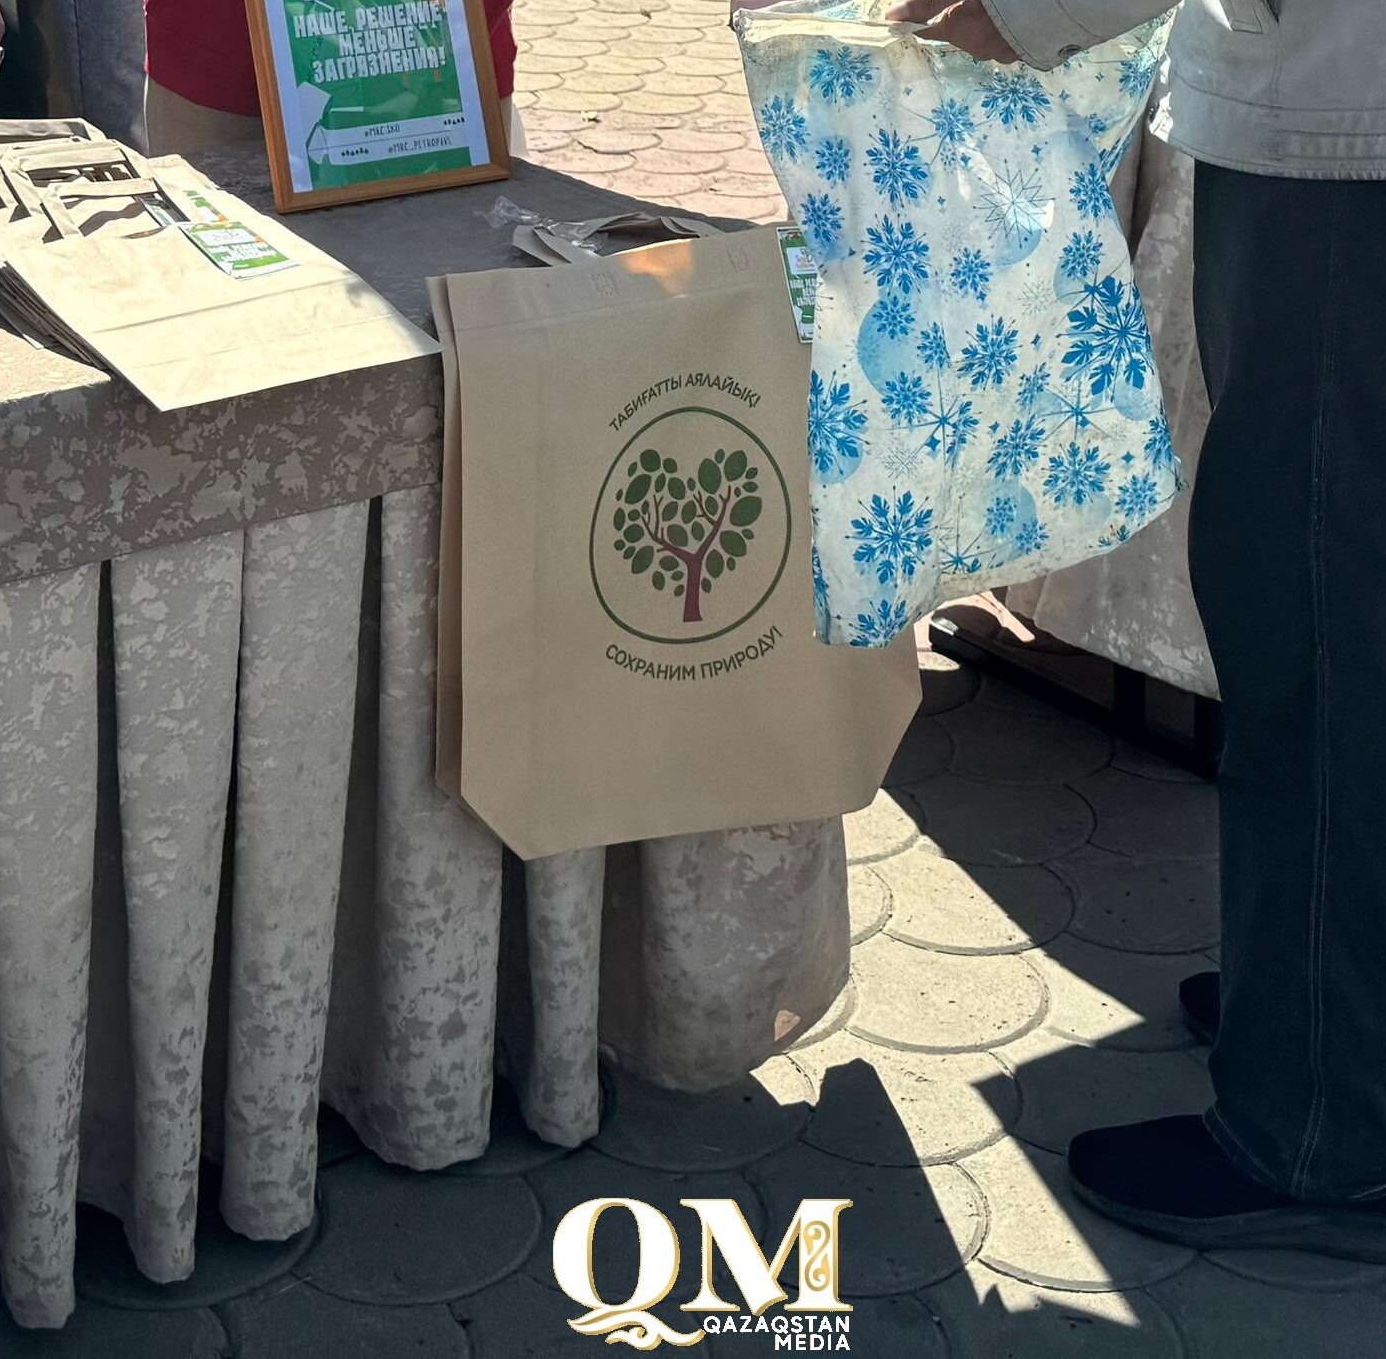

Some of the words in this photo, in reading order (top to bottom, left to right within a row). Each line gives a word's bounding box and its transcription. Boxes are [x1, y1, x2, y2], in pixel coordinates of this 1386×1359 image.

[293, 10, 348, 38] НАШЕ
[355, 0, 442, 30] РЕШЕНИЕ
[339, 26, 416, 57] МЕНЬШЕ
[312, 46, 446, 84] ЗАГРЯЗНЕНИЯ!
[609, 374, 682, 432] ТАБИҒАТТЫ
[685, 372, 762, 408] АЯЛАЙЫҚ!
[605, 643, 696, 681] СОХРАНИМ
[701, 625, 784, 679] ПРИРОДУ!
